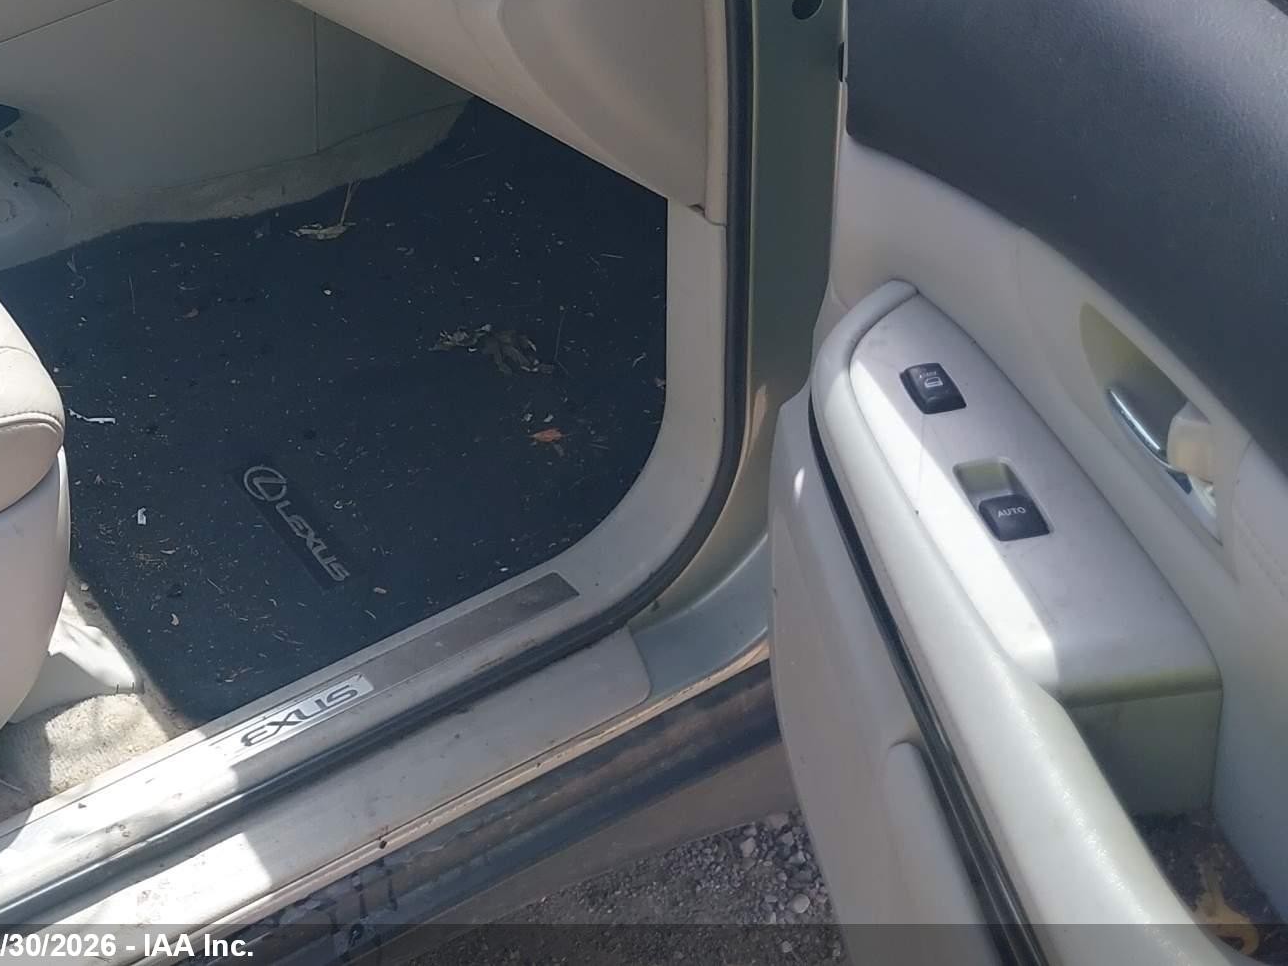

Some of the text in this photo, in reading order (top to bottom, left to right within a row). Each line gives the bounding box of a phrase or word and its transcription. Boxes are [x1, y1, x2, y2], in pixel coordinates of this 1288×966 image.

[275, 500, 351, 581] LEXUS
[997, 506, 1026, 518] AUTO
[236, 684, 359, 750] EXUS
